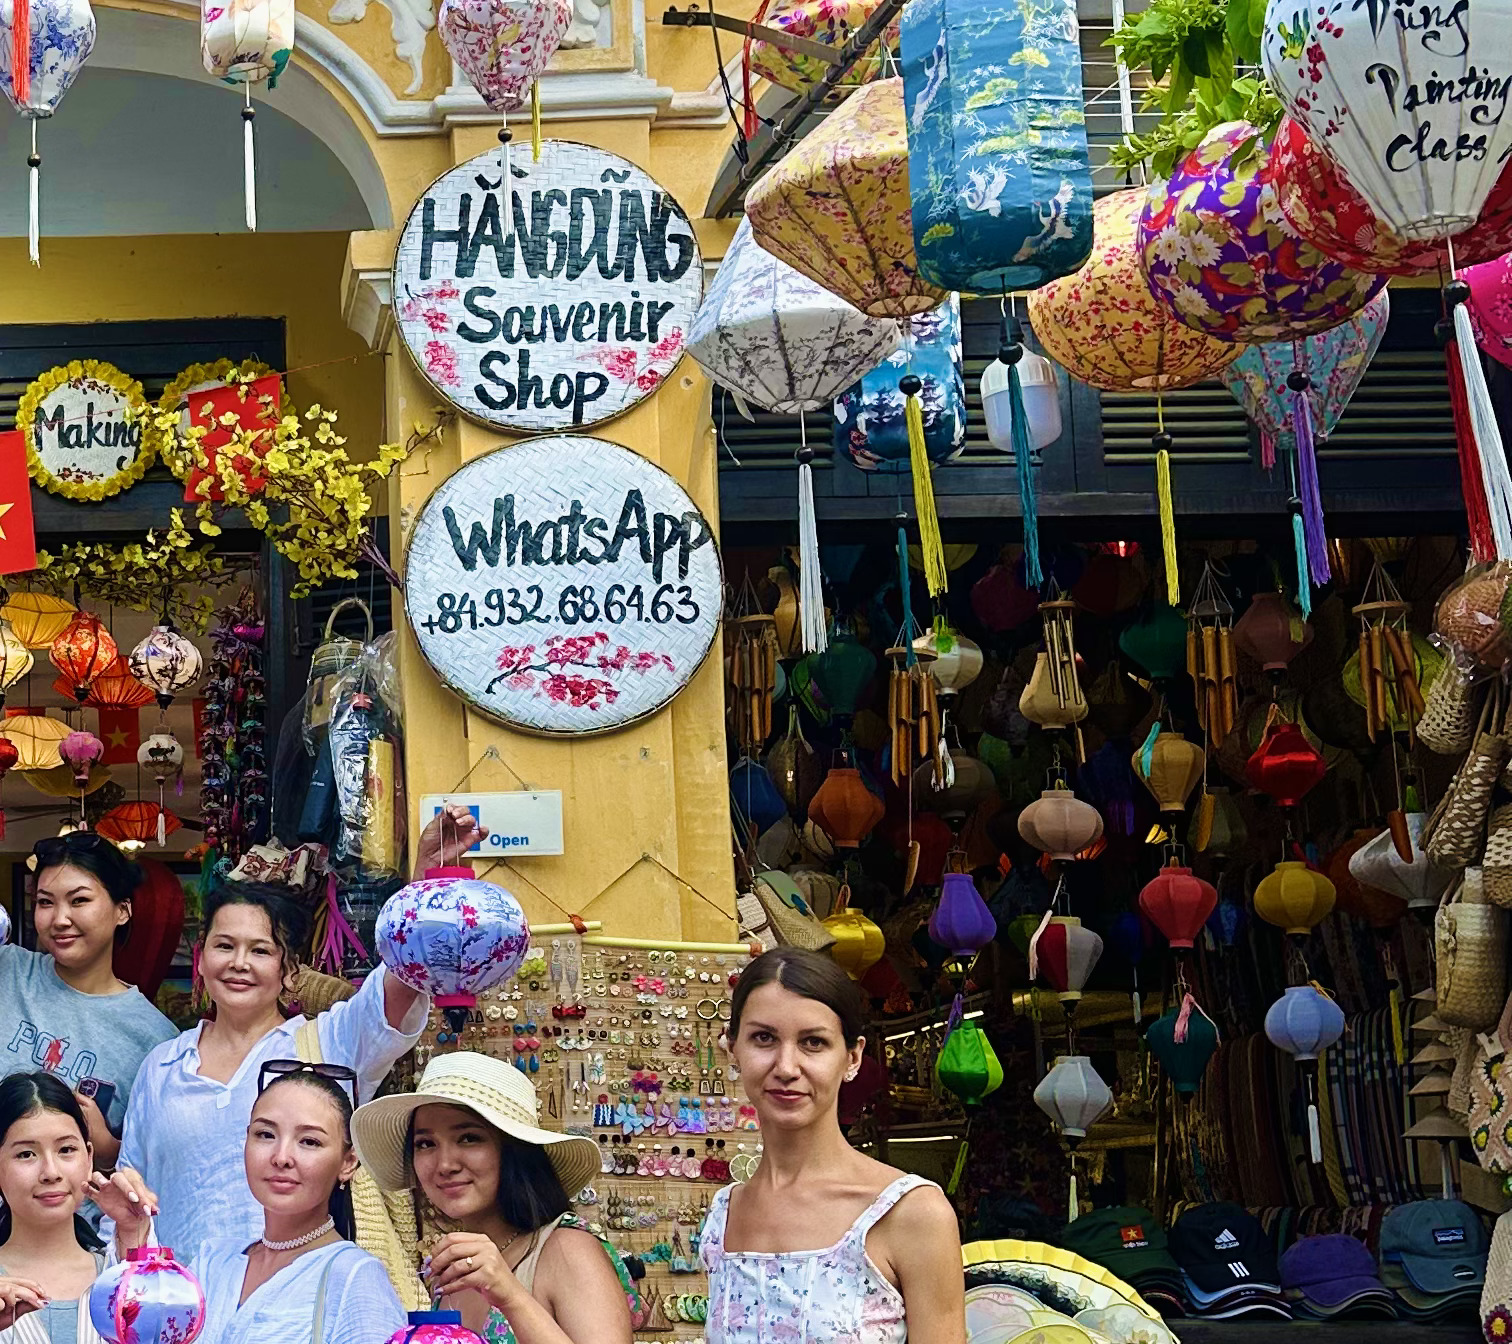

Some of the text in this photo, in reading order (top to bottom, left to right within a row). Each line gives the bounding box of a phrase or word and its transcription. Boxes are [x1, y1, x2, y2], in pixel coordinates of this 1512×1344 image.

[1364, 62, 1512, 126] Painting
[1385, 120, 1487, 173] Class
[473, 349, 609, 425] Shop
[442, 489, 710, 585] WhatsApp
[490, 833, 529, 849] Open
